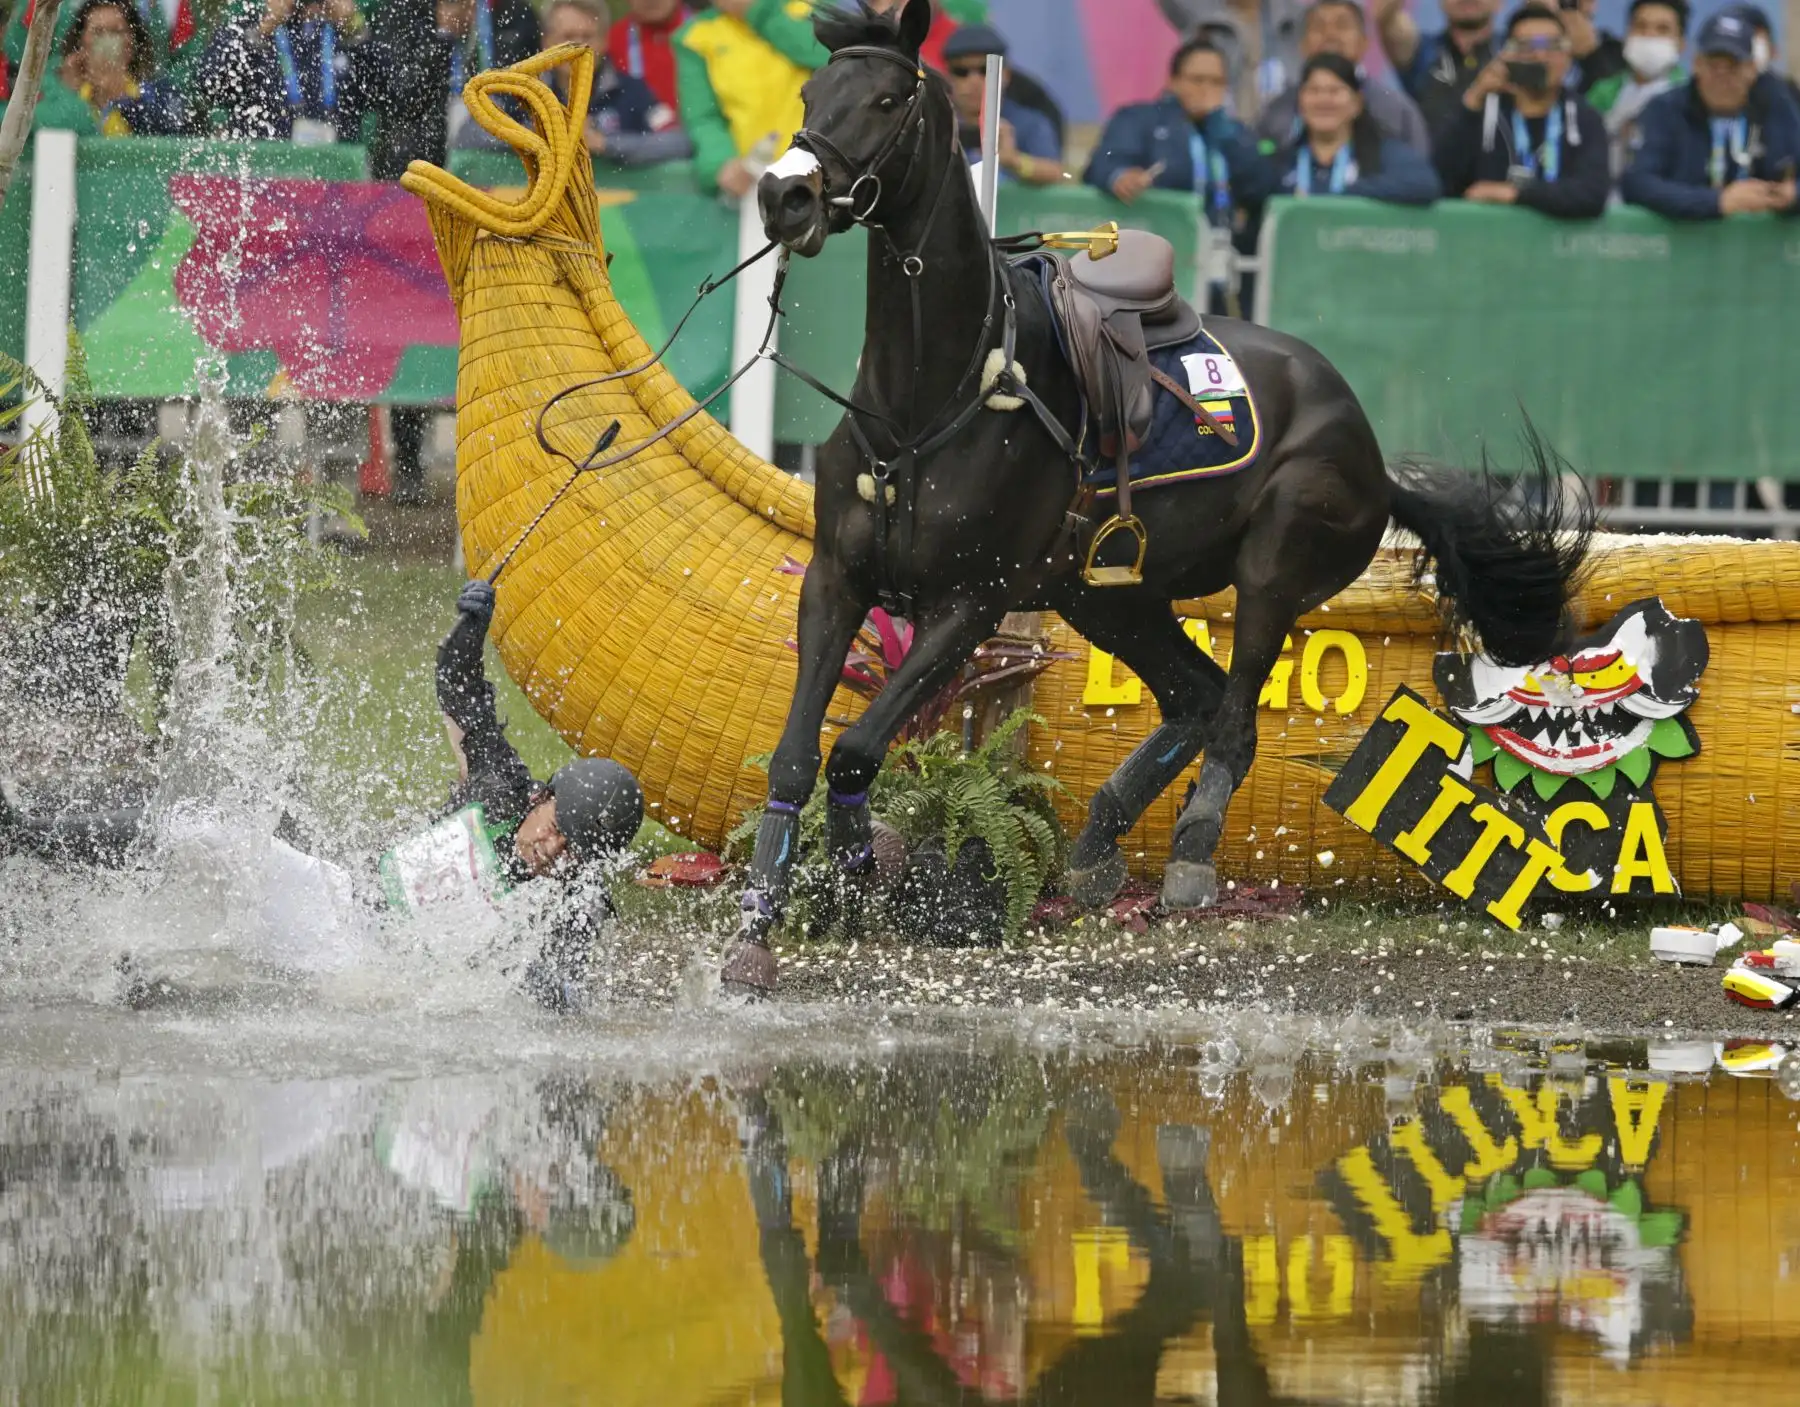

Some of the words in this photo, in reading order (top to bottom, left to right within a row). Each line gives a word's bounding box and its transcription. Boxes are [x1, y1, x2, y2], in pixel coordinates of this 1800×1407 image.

[1205, 358, 1222, 385] 8
[1197, 423, 1235, 435] COLIA
[1083, 618, 1368, 714] LO
